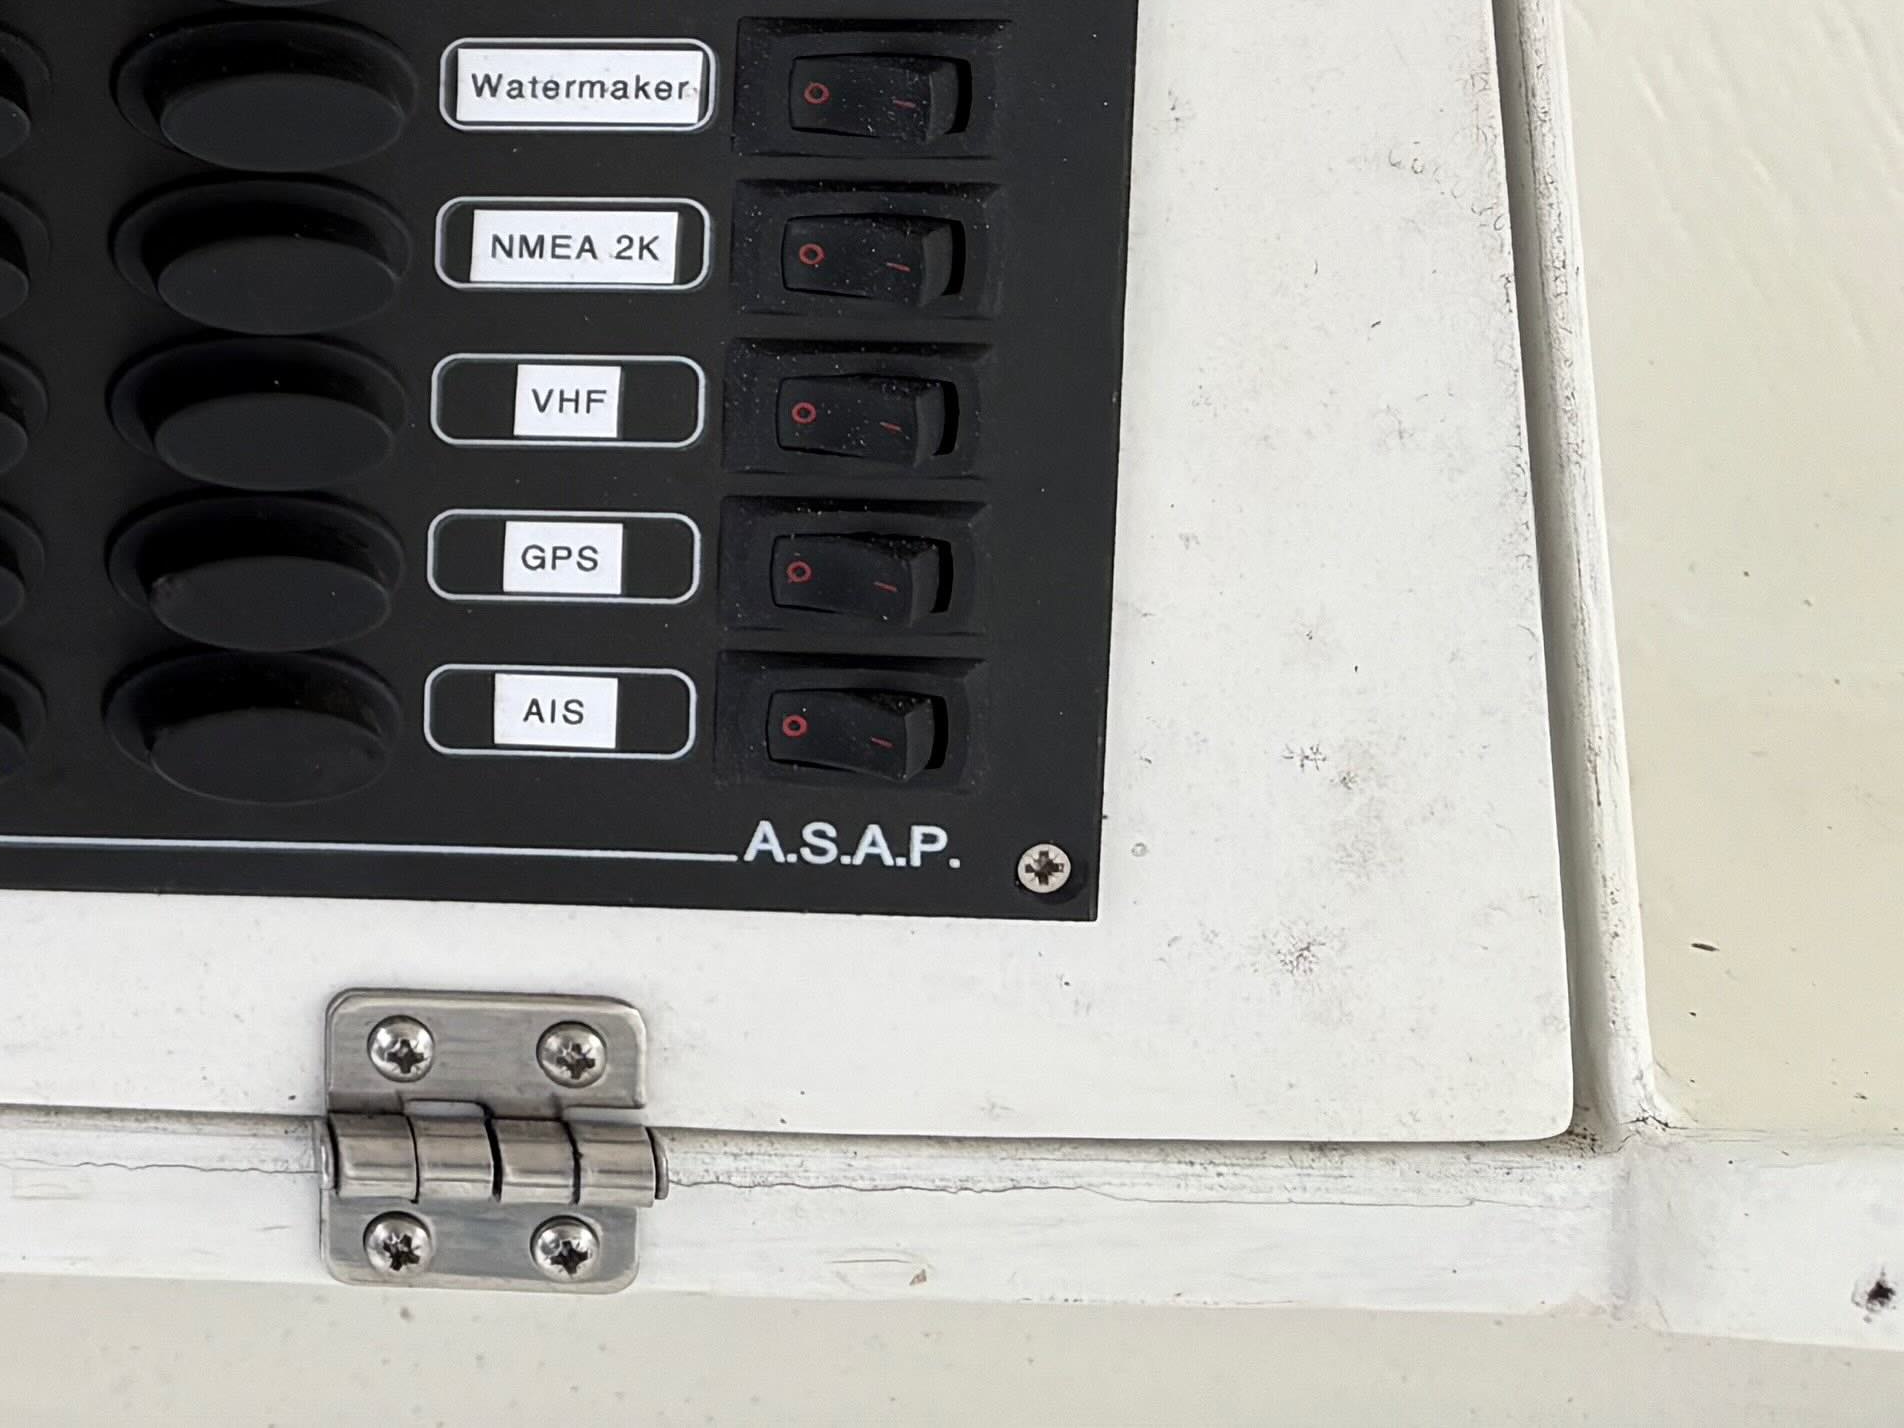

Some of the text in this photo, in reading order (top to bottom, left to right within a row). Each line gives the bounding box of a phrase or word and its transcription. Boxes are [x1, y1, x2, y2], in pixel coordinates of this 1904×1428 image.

[471, 73, 689, 101] Watermaker
[491, 233, 660, 261] NMEA 2K
[531, 388, 607, 415] VHF
[521, 544, 599, 573] GPS
[522, 697, 584, 726] AIS
[743, 820, 961, 869] A.S.A.P.
